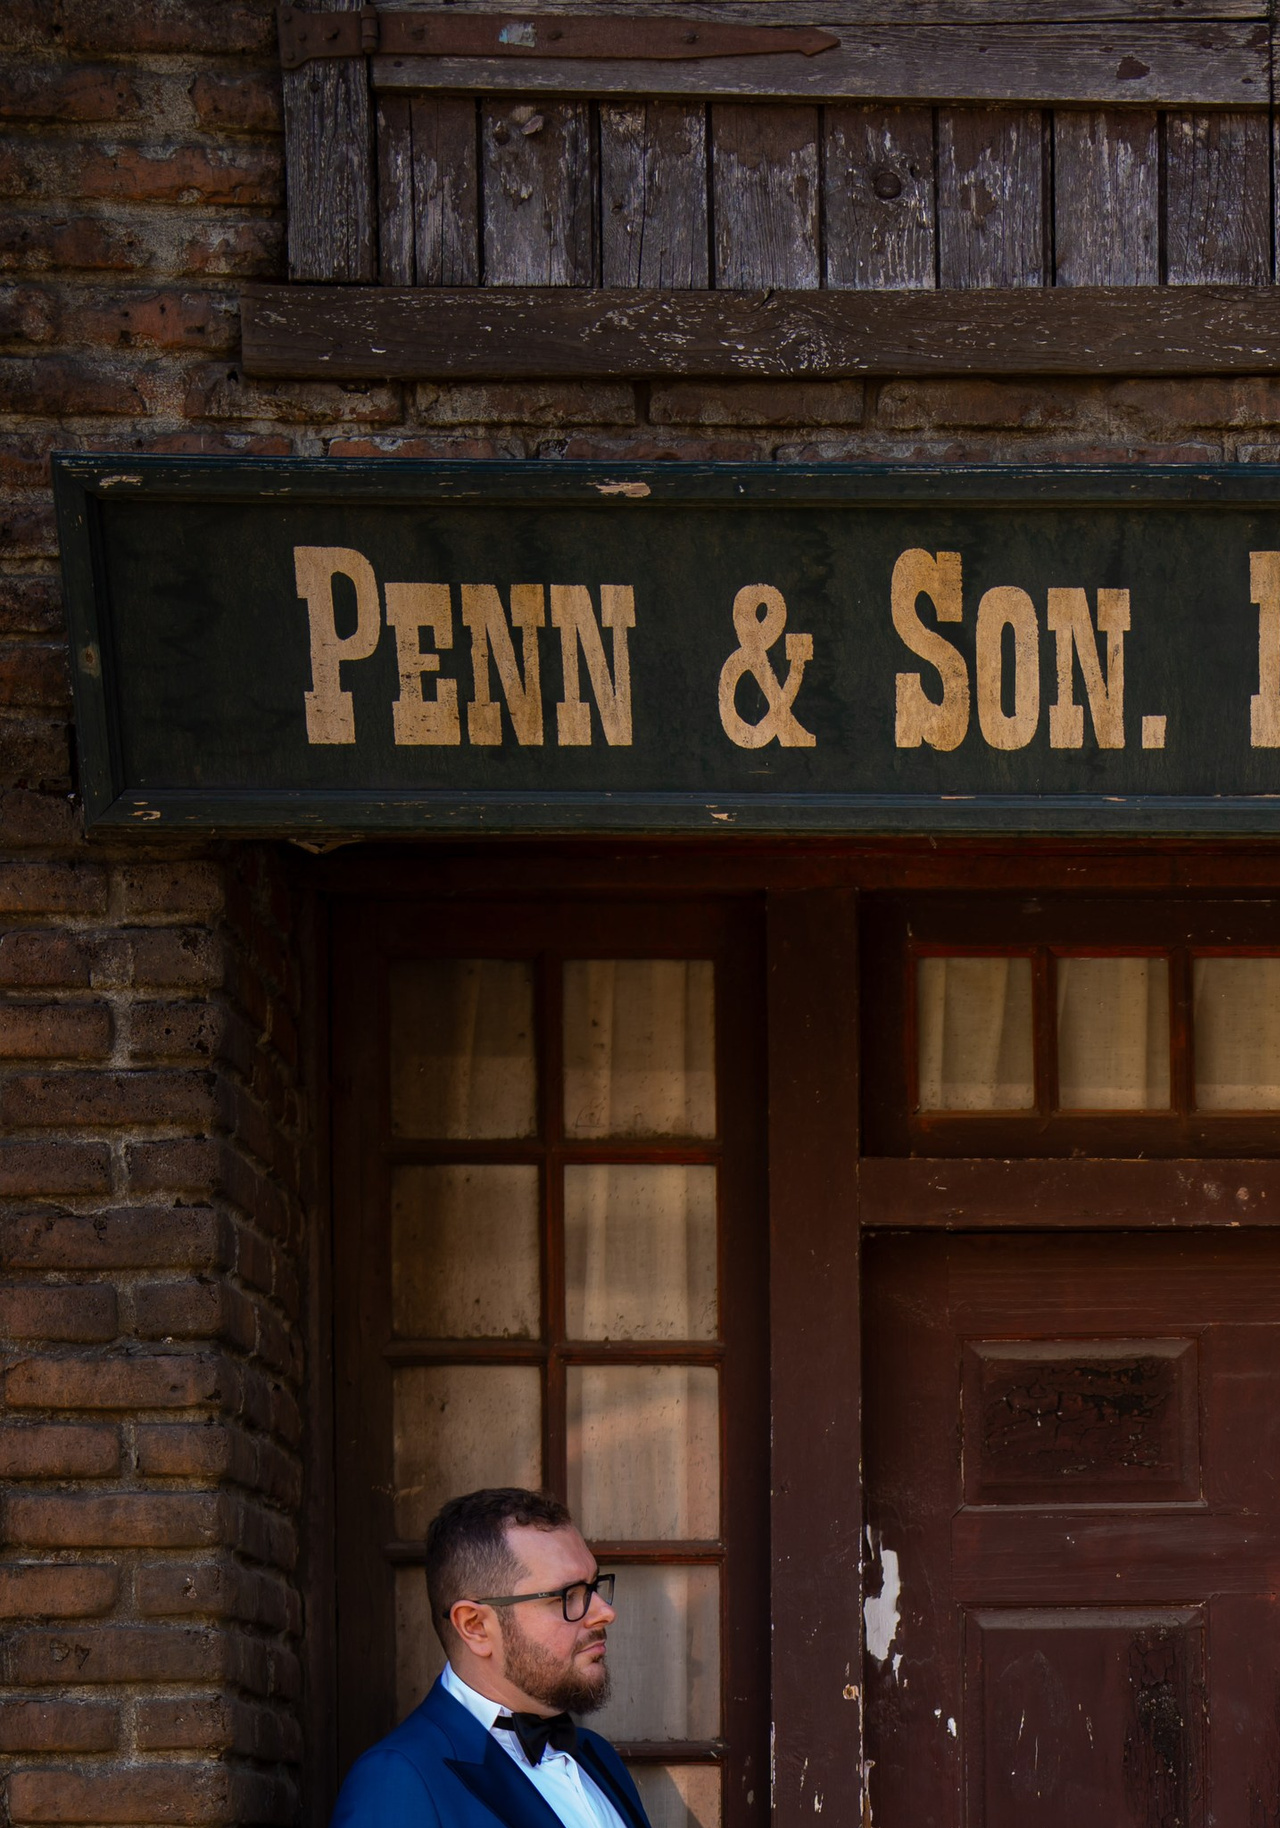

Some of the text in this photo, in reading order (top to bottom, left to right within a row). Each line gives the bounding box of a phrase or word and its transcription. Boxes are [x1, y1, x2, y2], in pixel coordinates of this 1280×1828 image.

[293, 546, 636, 747] PENN
[717, 583, 817, 750] &
[890, 547, 1168, 752] SON.
